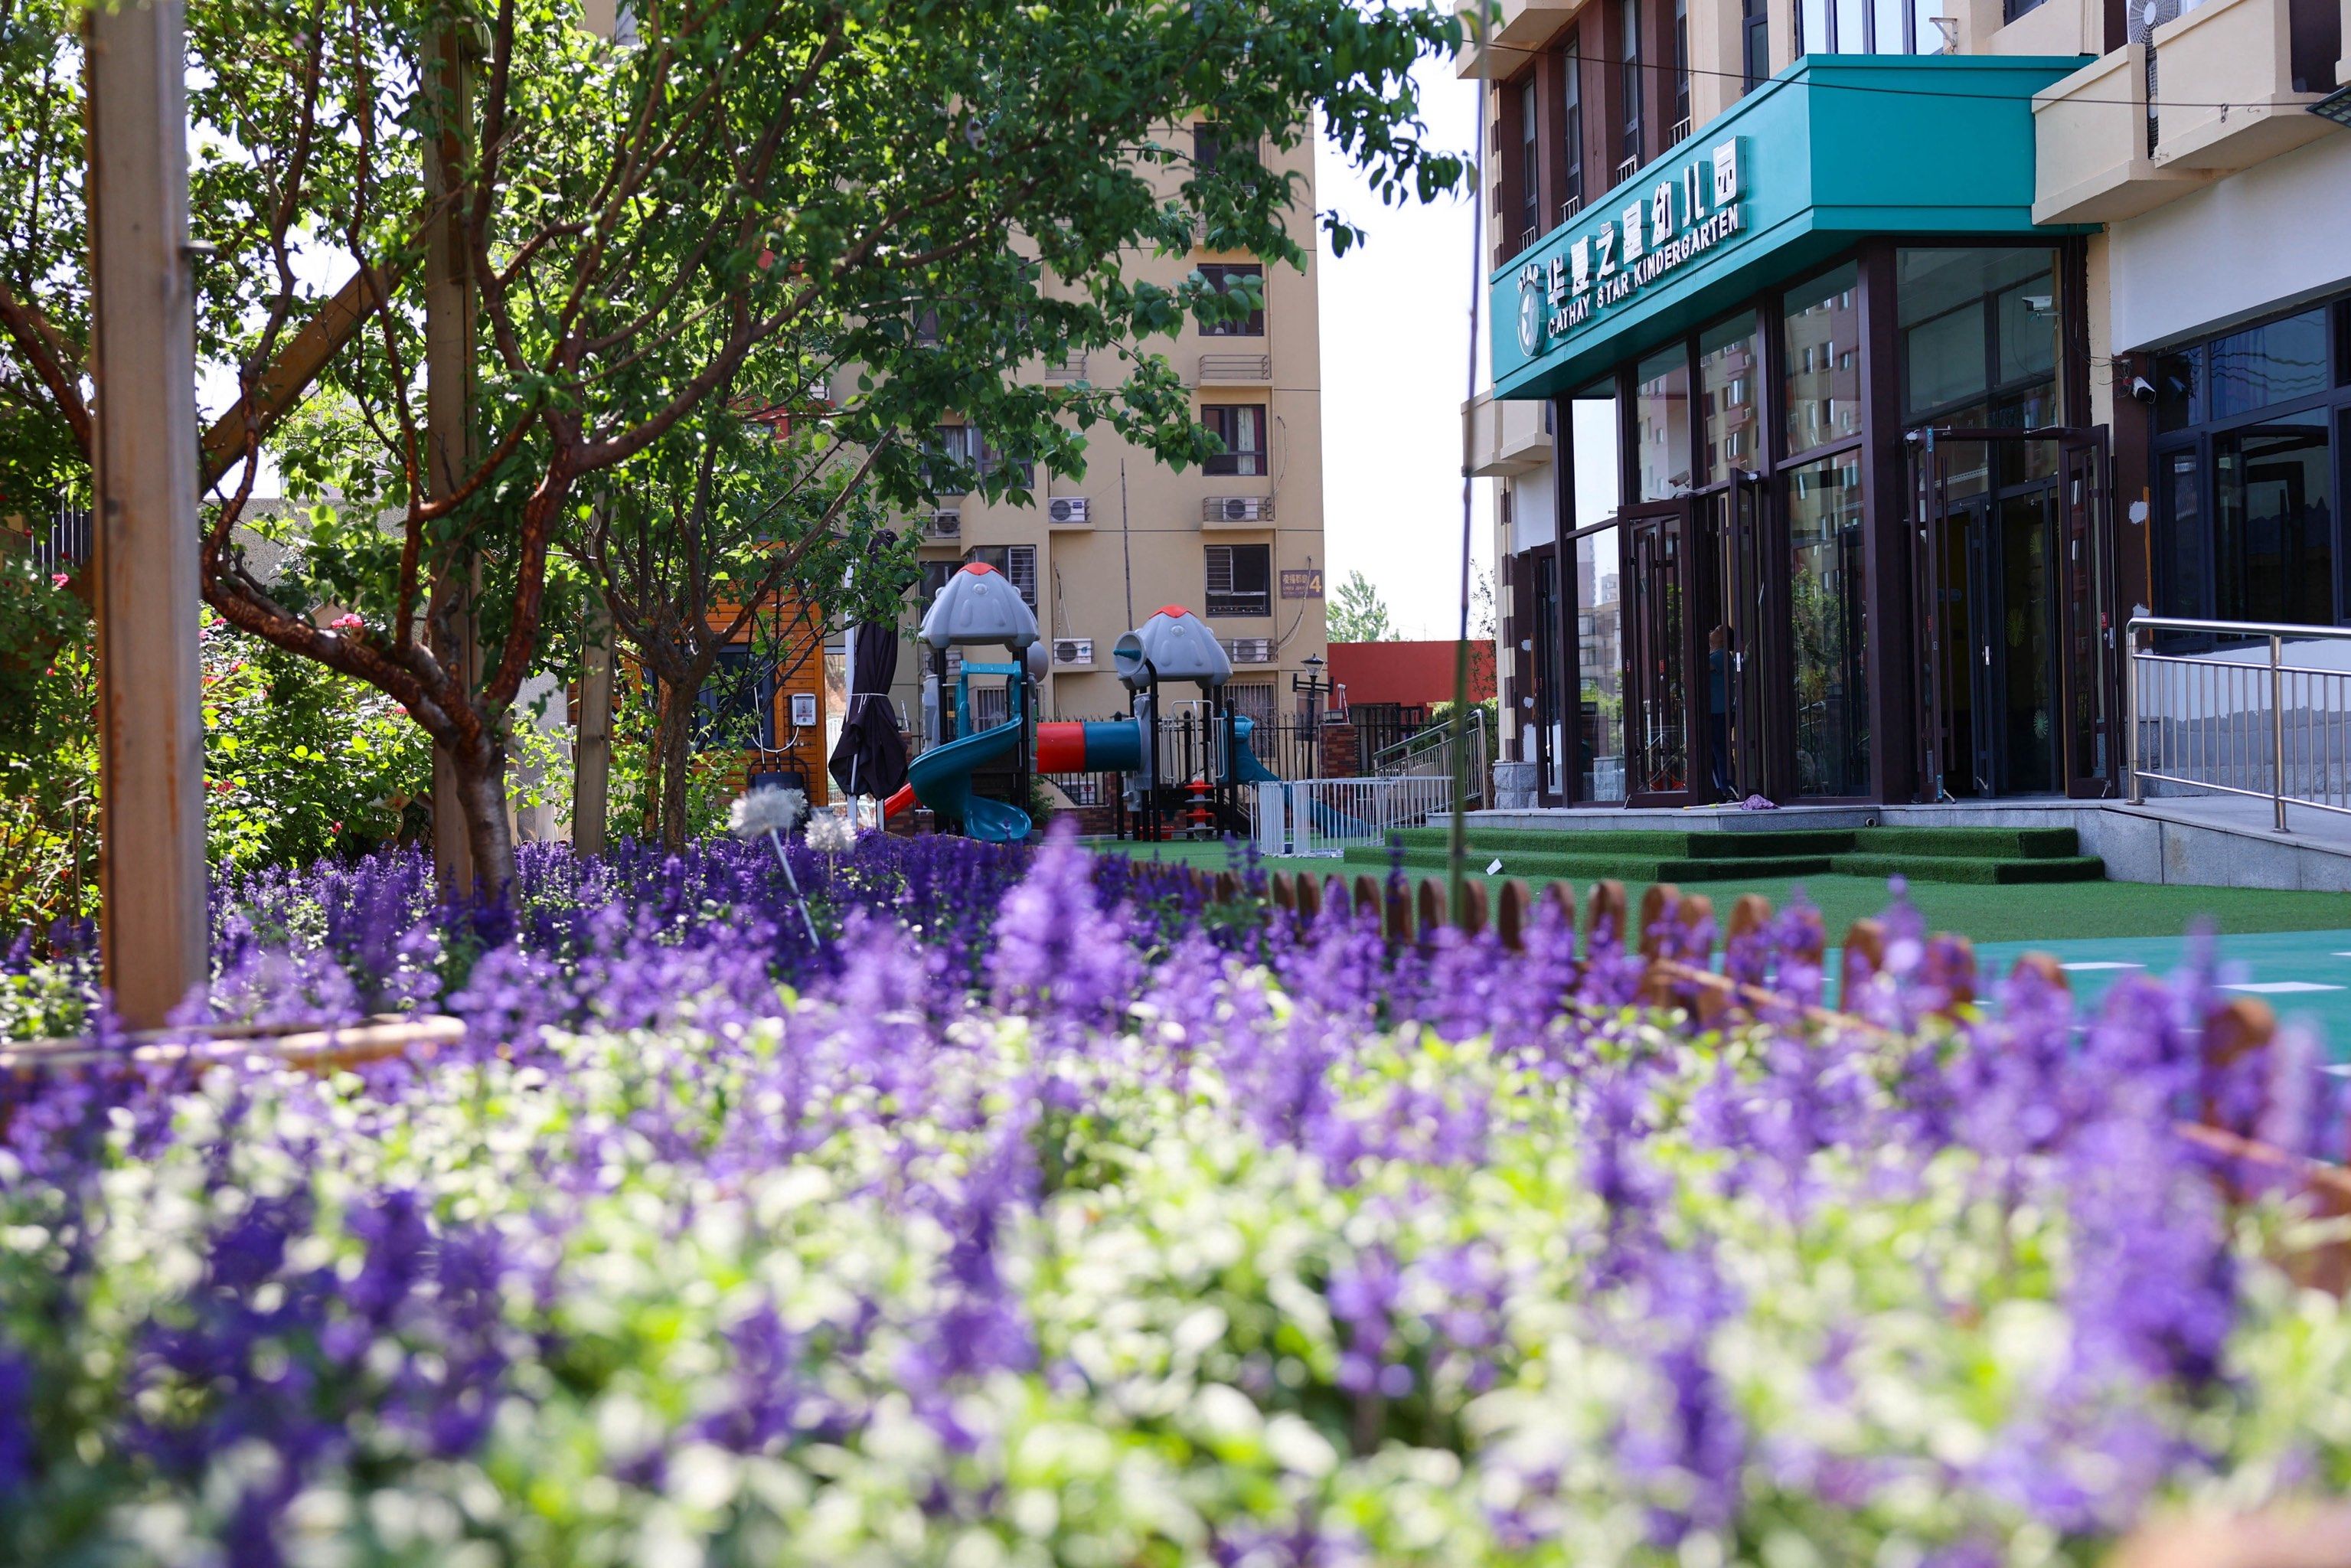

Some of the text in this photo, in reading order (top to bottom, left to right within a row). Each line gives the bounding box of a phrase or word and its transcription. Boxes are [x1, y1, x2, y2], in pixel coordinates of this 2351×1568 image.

[1547, 136, 1737, 309] 华夏之星幼儿园
[1548, 204, 1739, 338] CATHAY STAR KINDERGARTEN
[1309, 575, 1322, 593] 4
